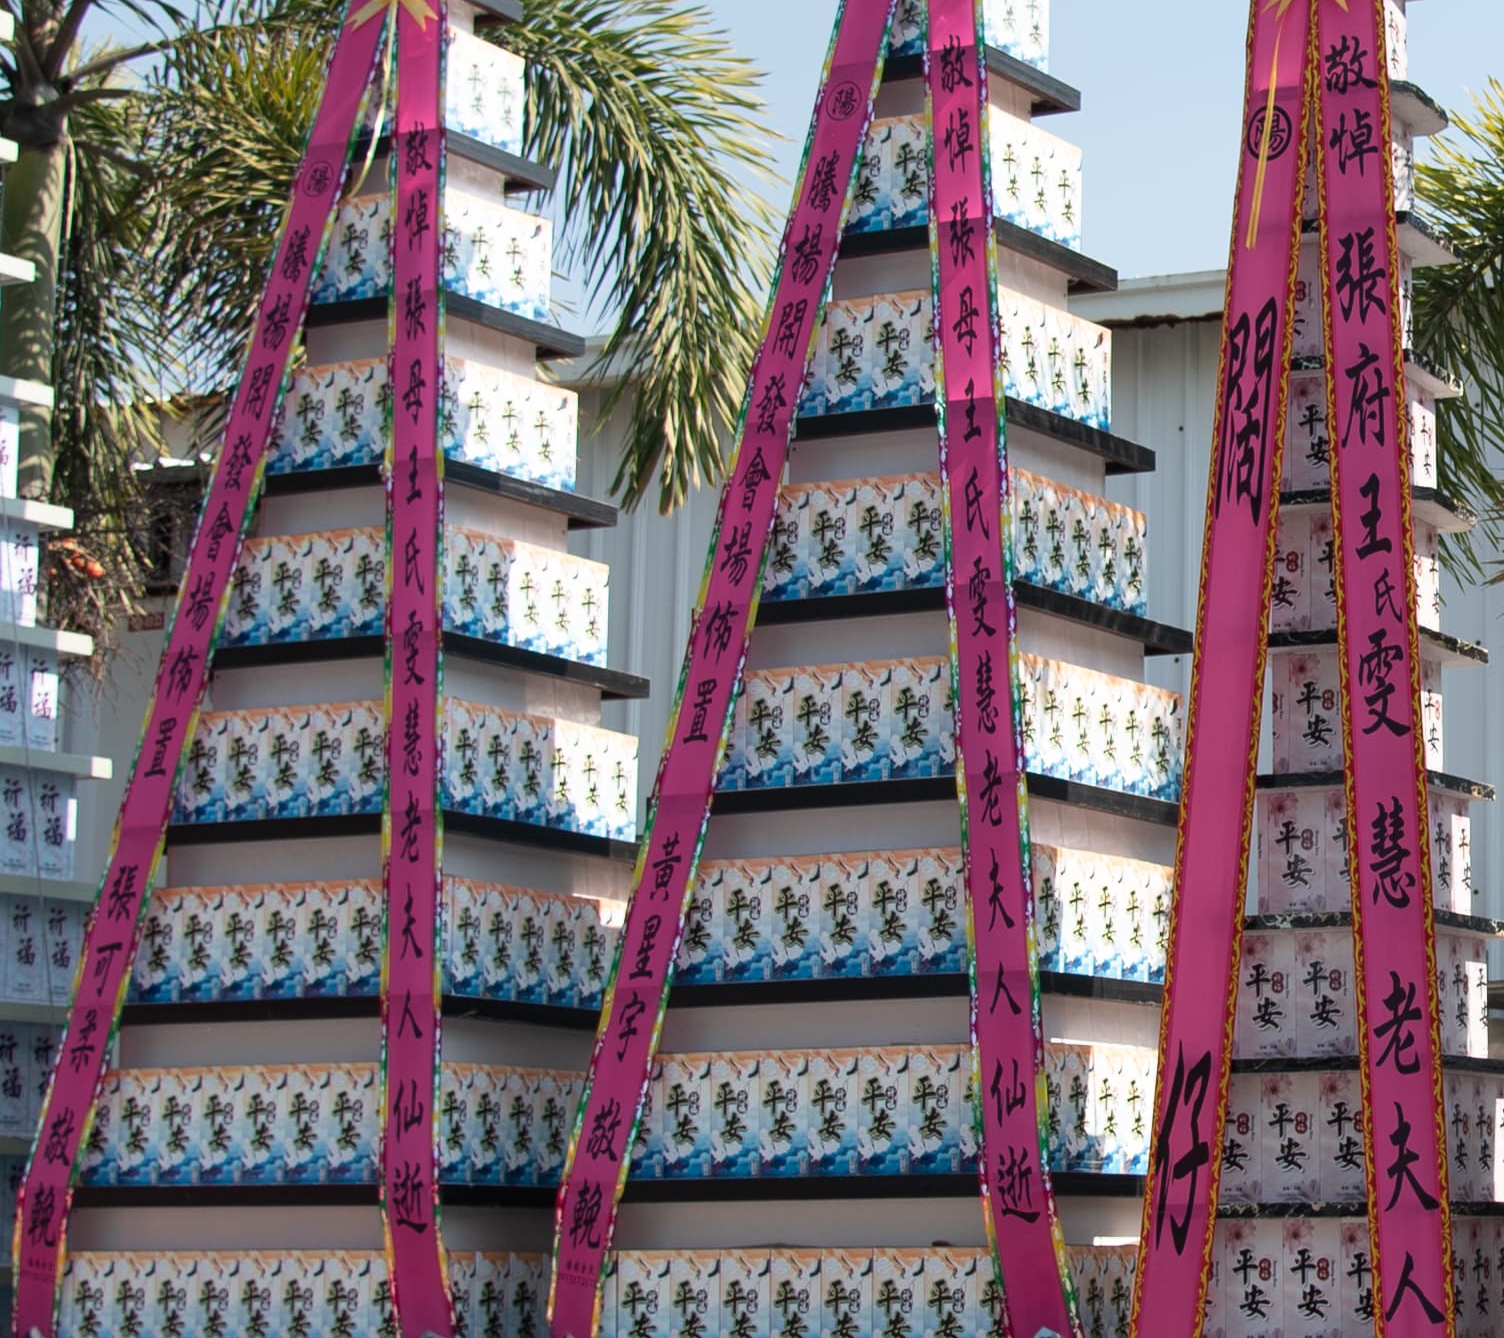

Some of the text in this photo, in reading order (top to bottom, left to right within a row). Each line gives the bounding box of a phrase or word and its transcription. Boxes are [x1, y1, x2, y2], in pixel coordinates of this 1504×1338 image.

[265, 910, 294, 966] 平安
[307, 908, 336, 964] 平安
[776, 885, 808, 947] 平安
[203, 1094, 232, 1150] 平安
[715, 1081, 747, 1143] 平安
[763, 1079, 795, 1141] 平安
[813, 1078, 845, 1140] 平安
[863, 1077, 895, 1139] 平安
[1290, 1249, 1330, 1317] 平安
